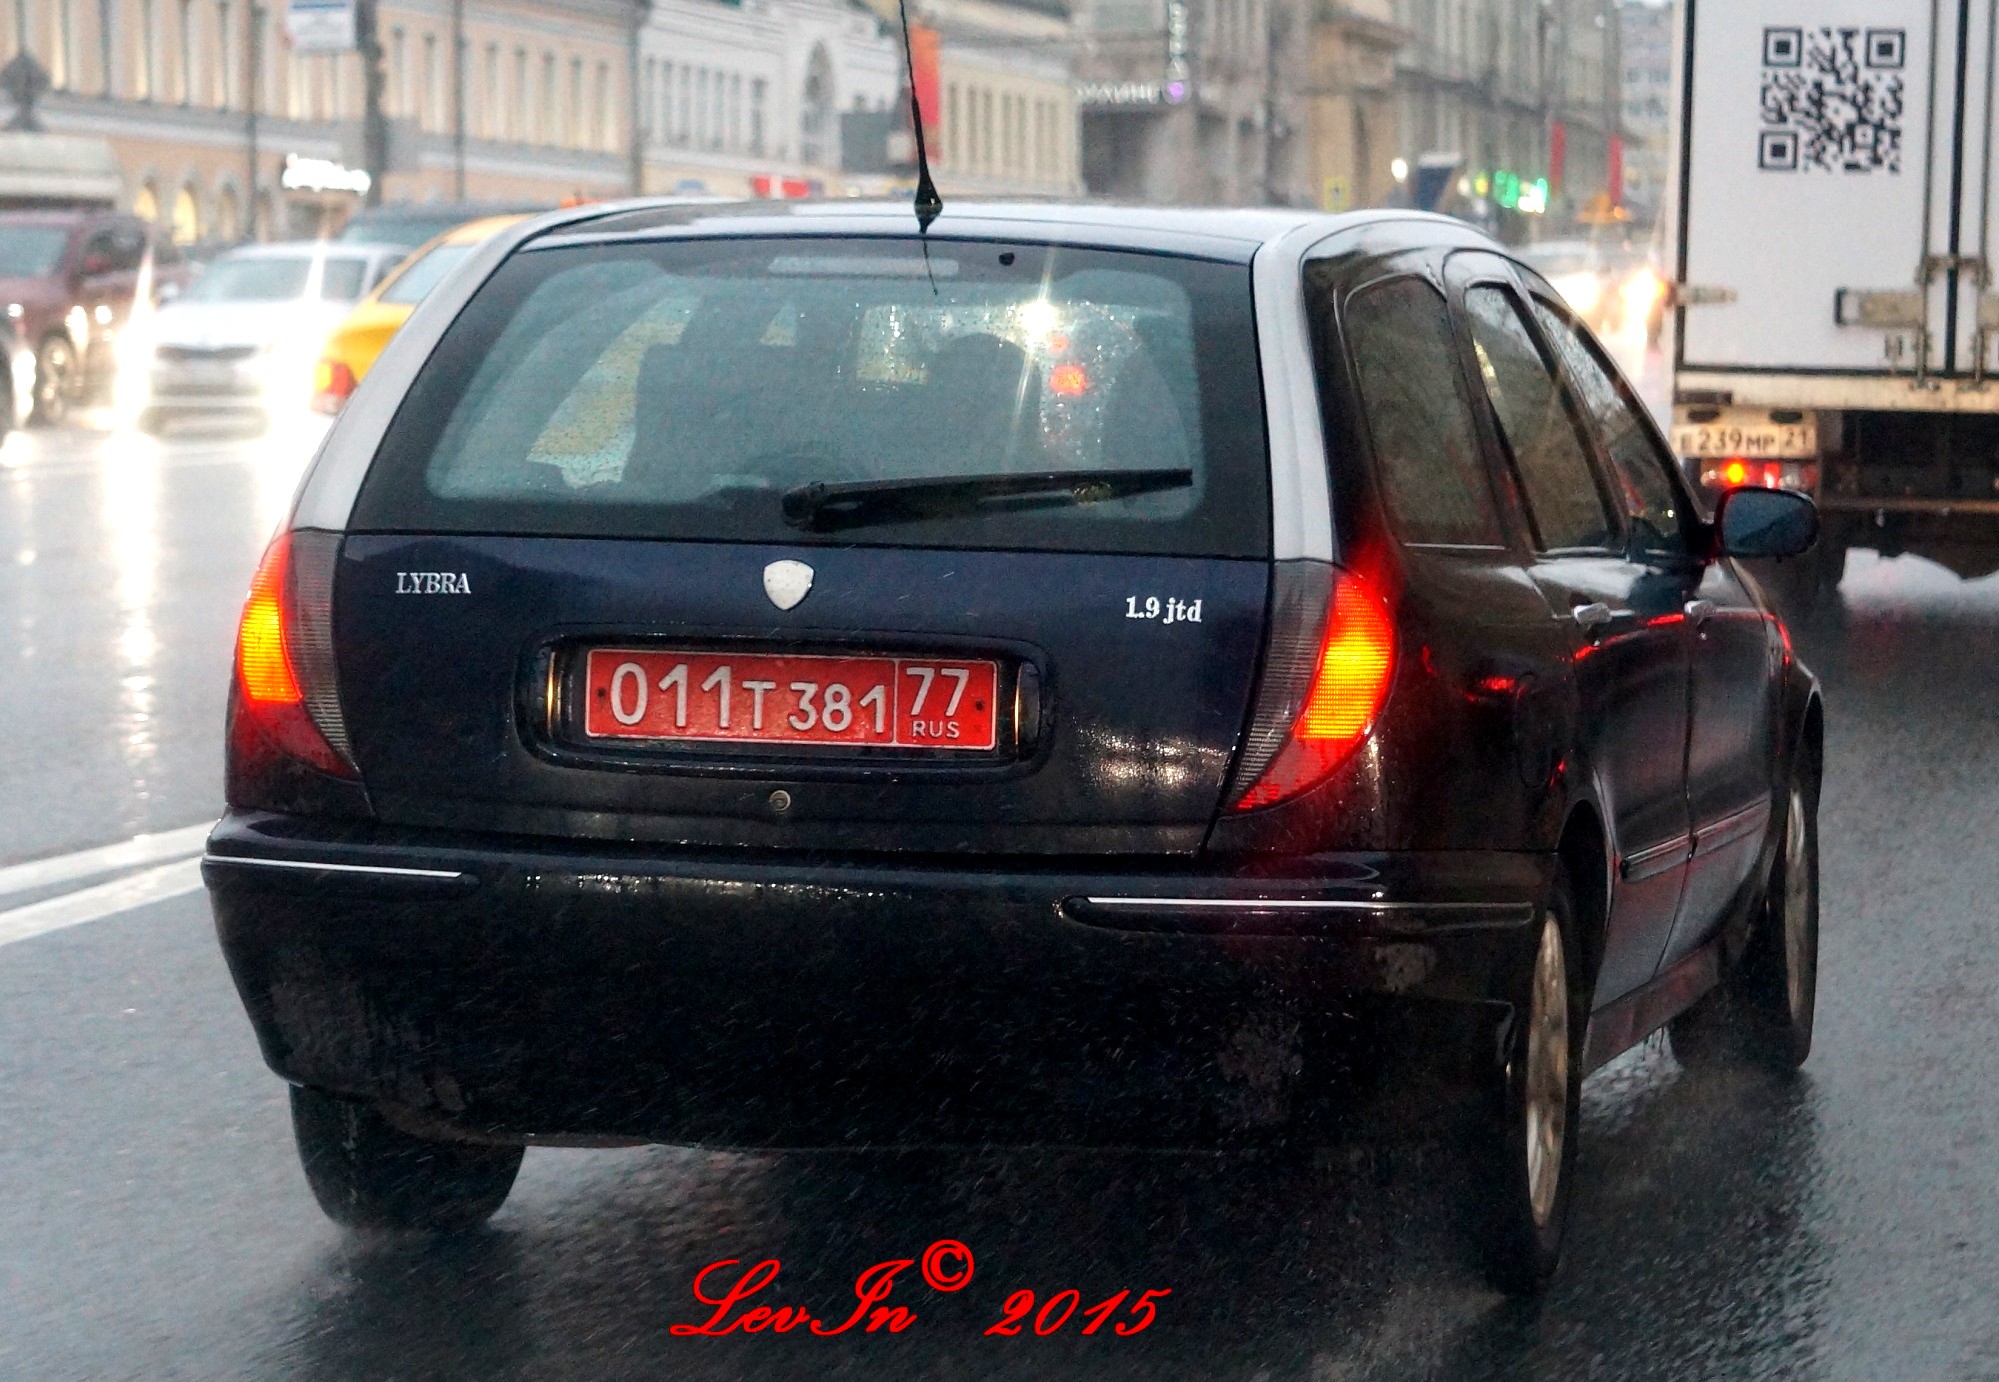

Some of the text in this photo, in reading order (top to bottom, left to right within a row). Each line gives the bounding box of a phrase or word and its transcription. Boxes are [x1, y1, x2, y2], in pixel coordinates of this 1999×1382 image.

[396, 572, 471, 594] LYBRA
[1125, 596, 1203, 624] 1.9 jtd
[906, 667, 970, 717] 77
[912, 720, 960, 739] RUS
